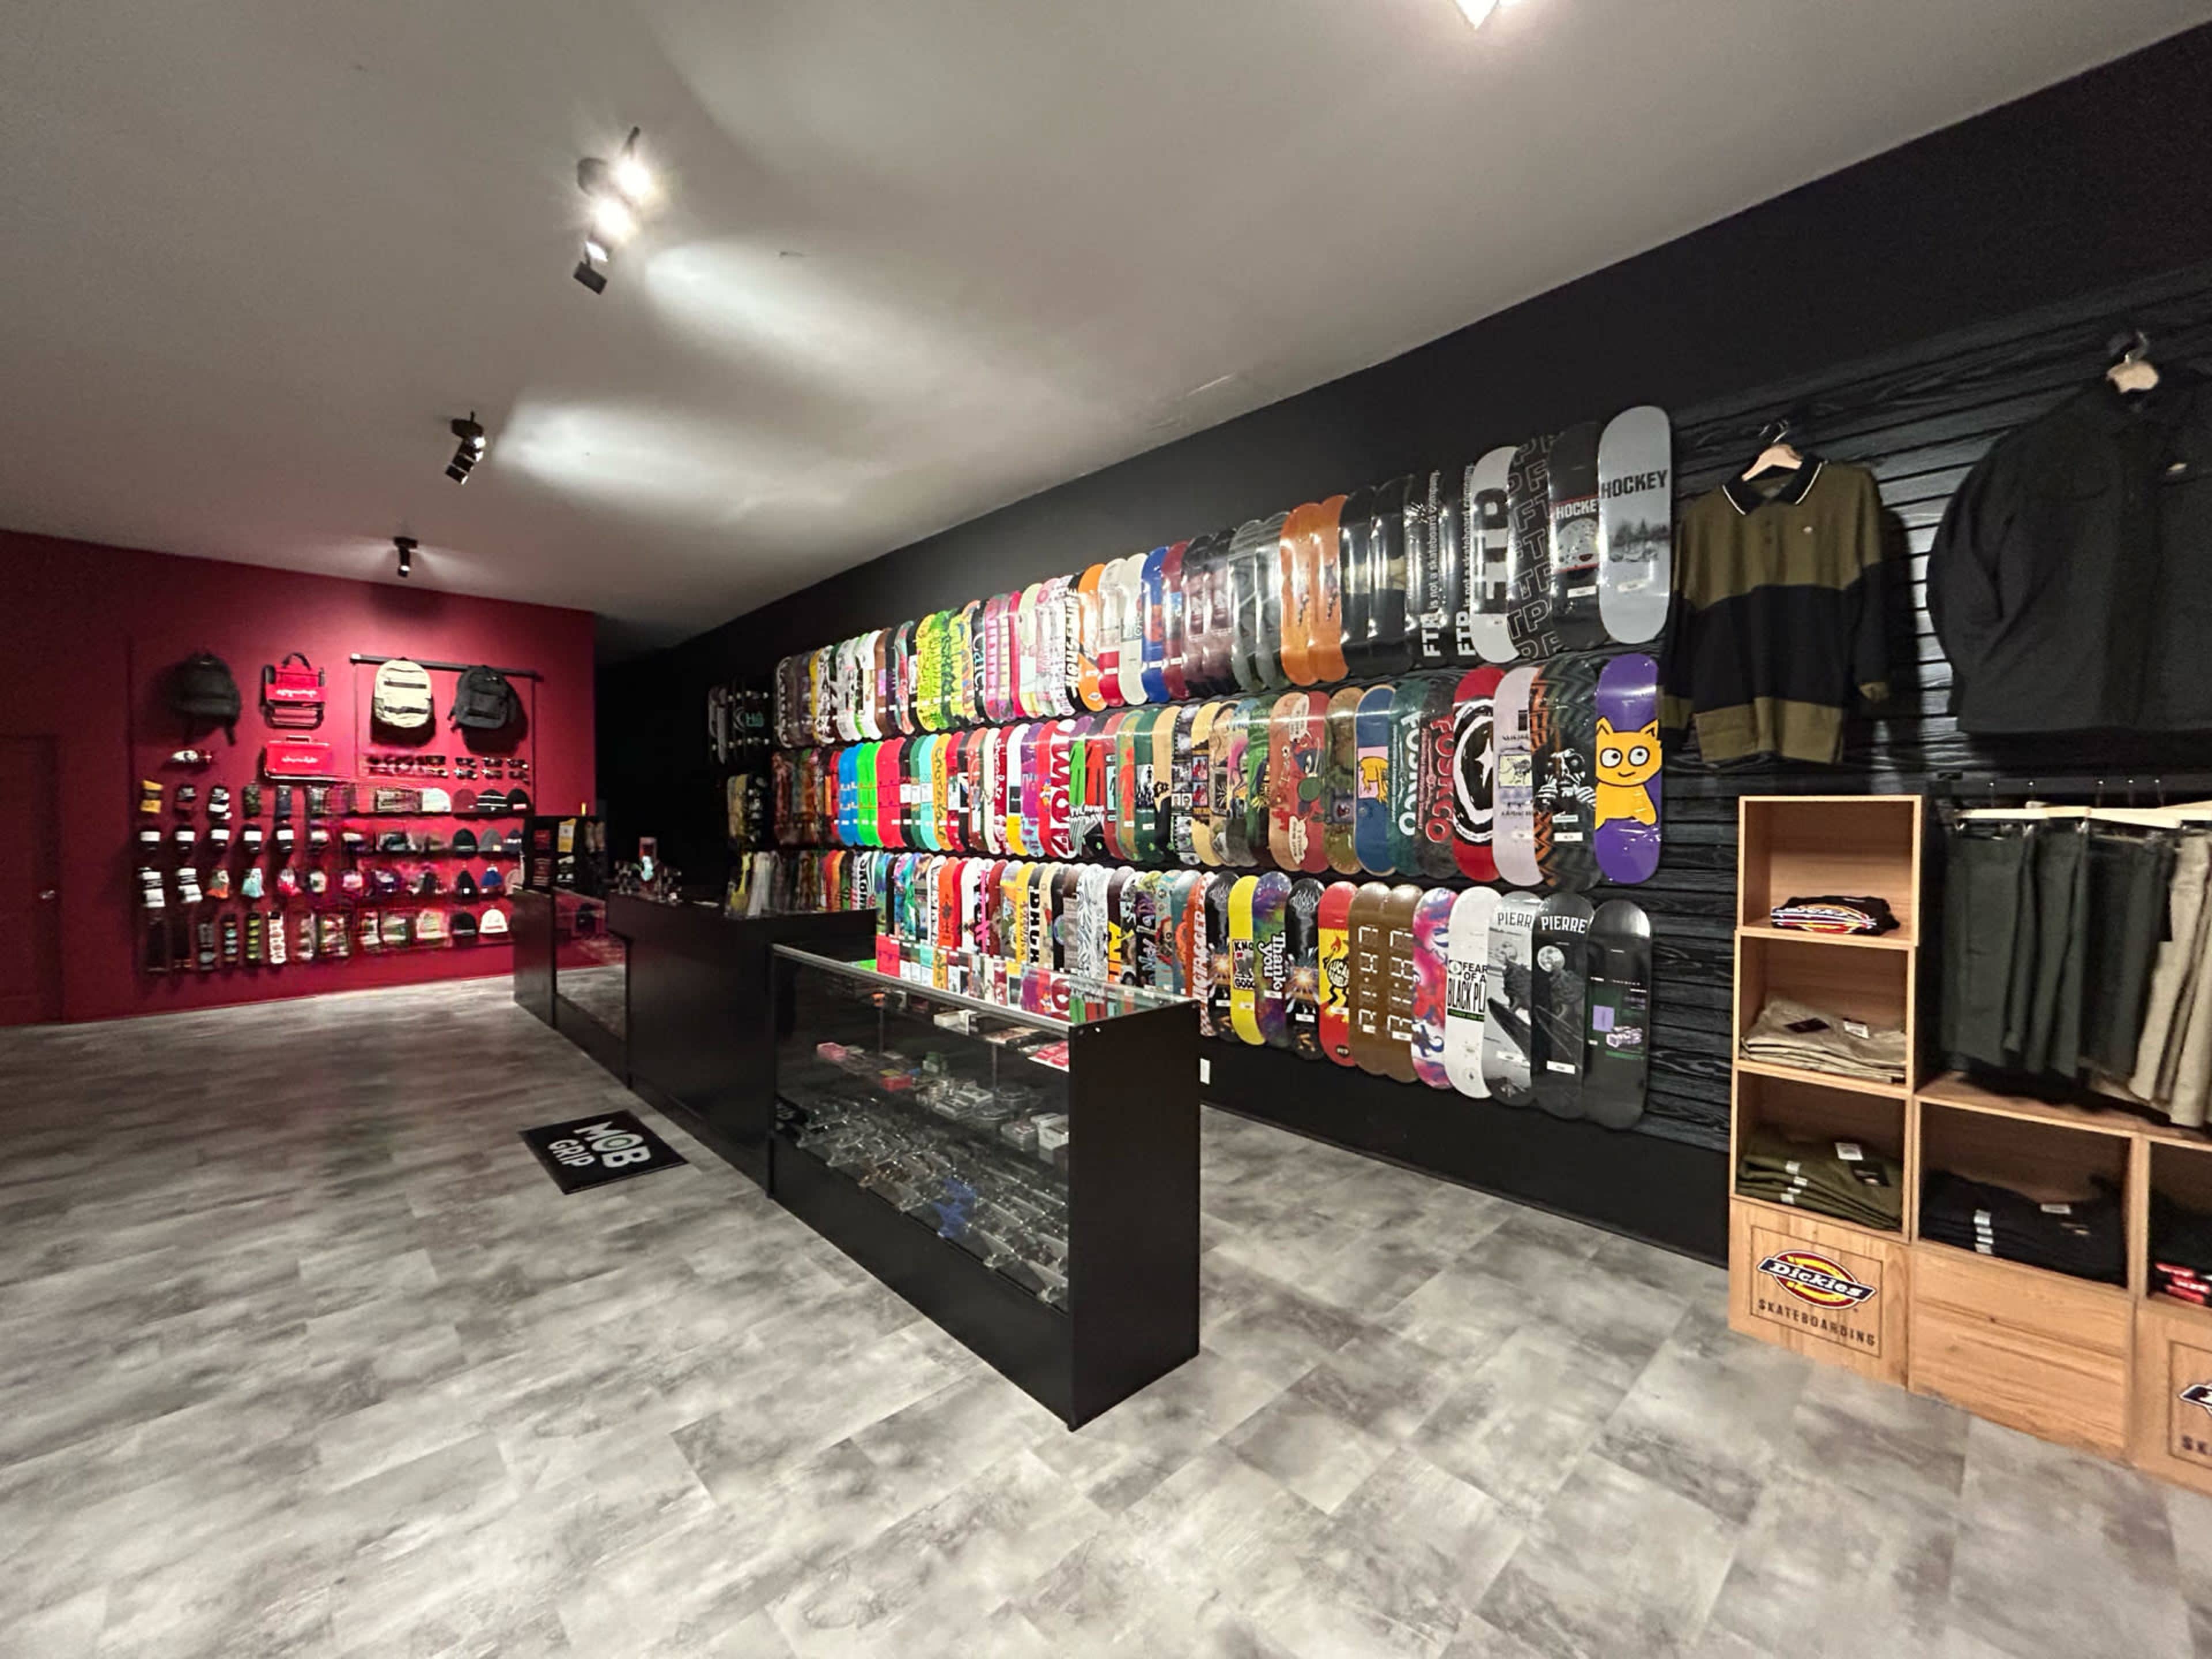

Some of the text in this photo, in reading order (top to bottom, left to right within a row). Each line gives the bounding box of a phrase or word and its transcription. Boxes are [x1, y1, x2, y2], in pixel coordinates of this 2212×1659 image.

[1601, 469, 1668, 499] HOCKEY
[1556, 498, 1600, 519] HOCKE
[1428, 515, 1438, 570] skateboard
[1474, 488, 1509, 614] FTP
[1428, 581, 1438, 598] not
[1455, 611, 1476, 656] FTP
[994, 738, 1006, 800] chocolate
[1497, 912, 1533, 929] PIERR
[1541, 915, 1588, 934] PIERRE
[1258, 942, 1272, 977] you
[1272, 931, 1286, 990] Thank
[1463, 963, 1488, 974] FEAR
[1463, 971, 1487, 983] OF A
[1448, 978, 1471, 1010] BLACK
[548, 1139, 595, 1166] GRIP
[573, 1121, 652, 1168] MOB
[1769, 1262, 1865, 1297] Dickies
[1758, 1298, 1876, 1346] SKATEBOARDING
